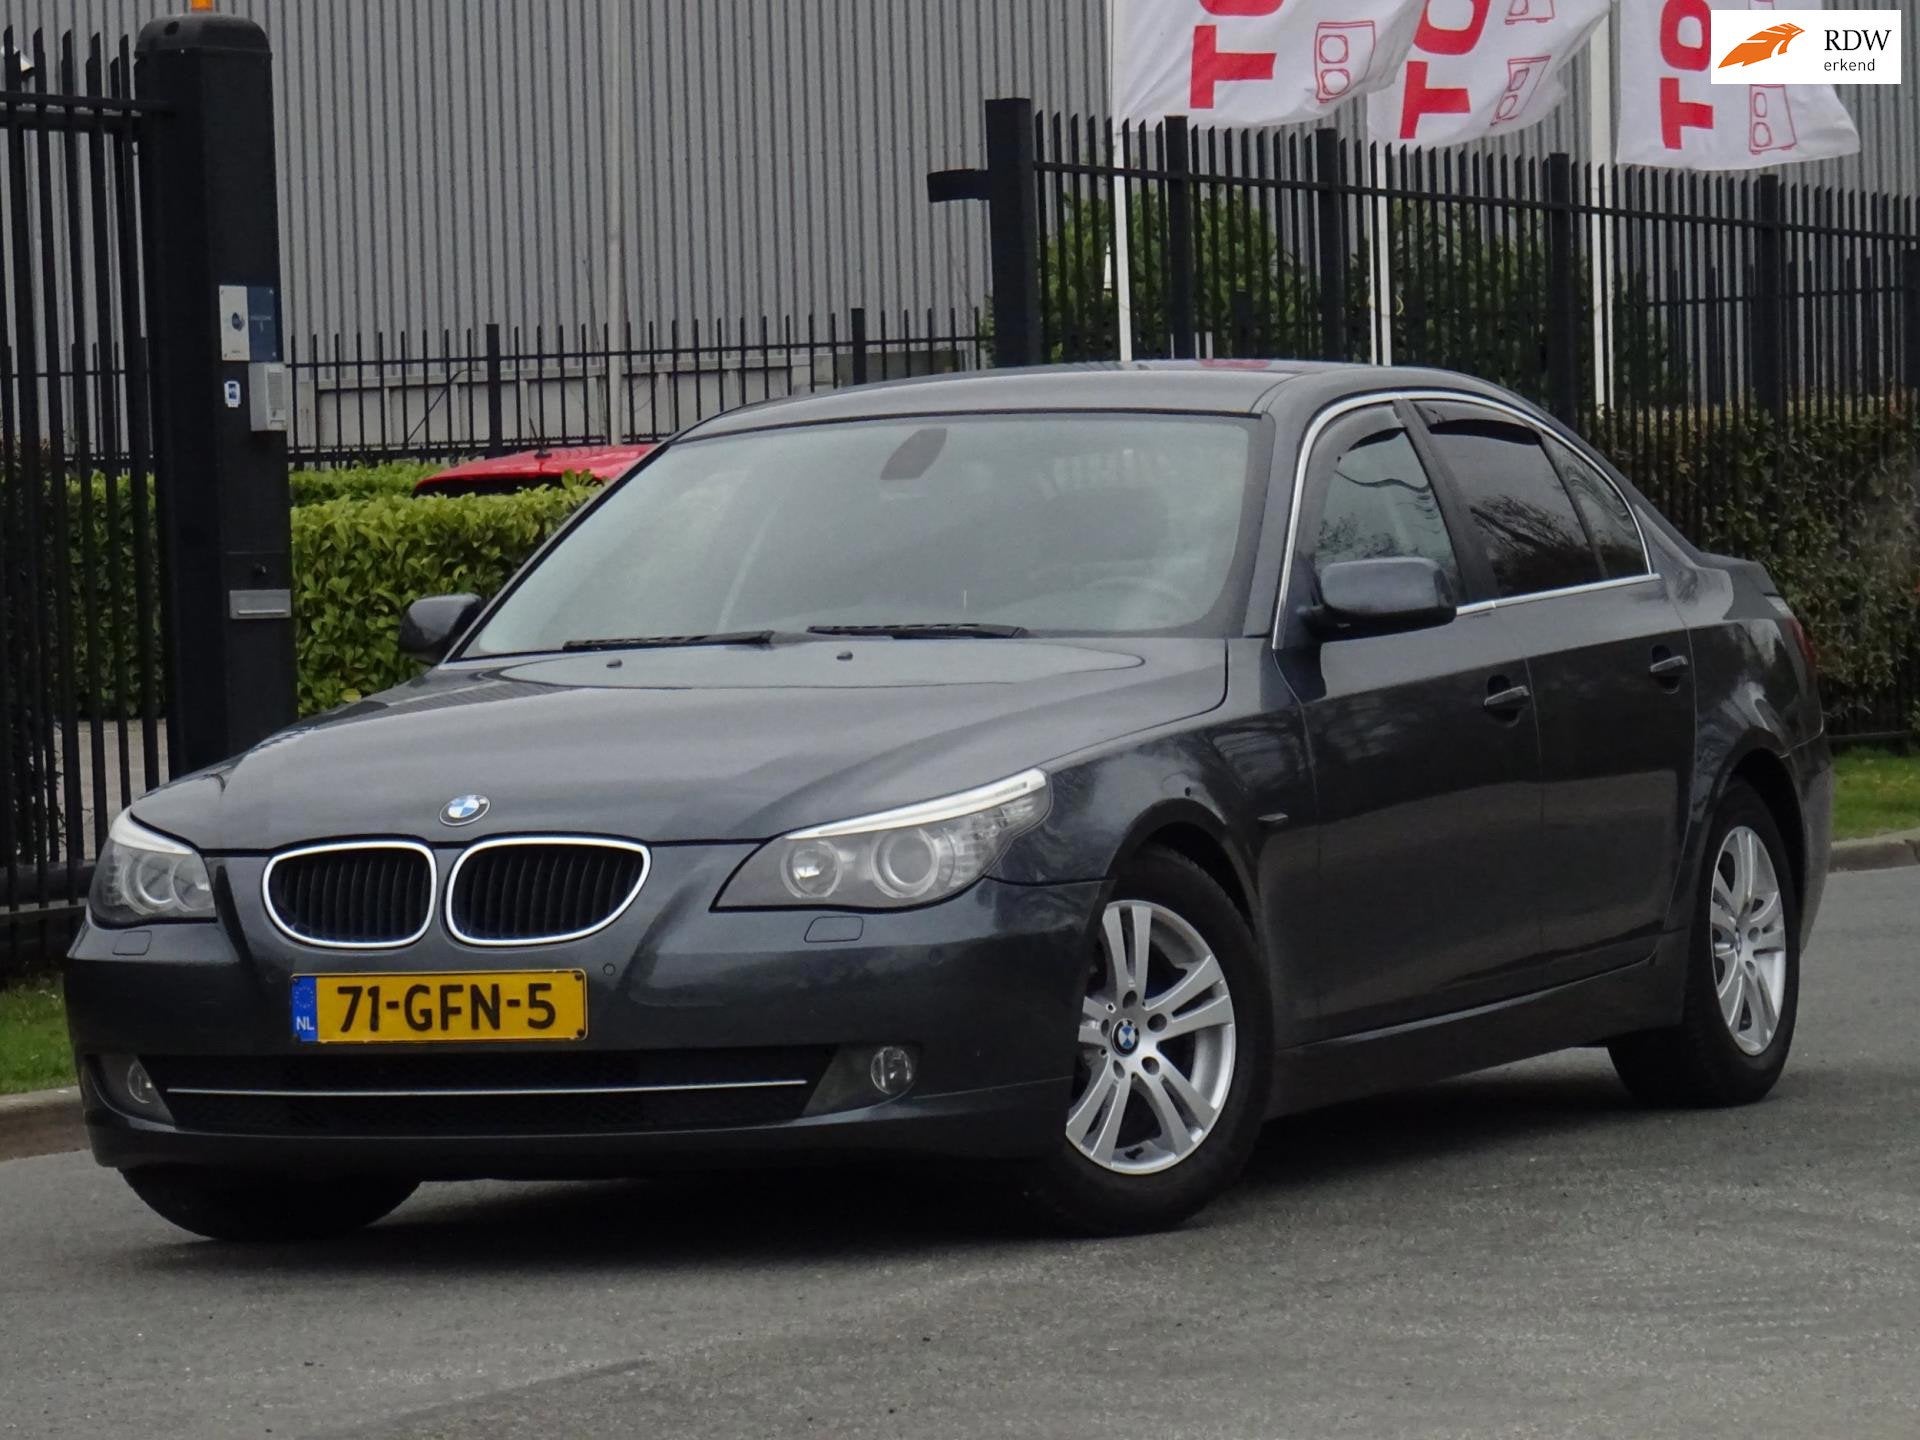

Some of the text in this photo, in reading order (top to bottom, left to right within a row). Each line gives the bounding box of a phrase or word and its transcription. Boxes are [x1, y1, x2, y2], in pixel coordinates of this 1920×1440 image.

[1190, 0, 1284, 108] T
[295, 1016, 315, 1031] NL
[336, 982, 556, 1033] 71-GFN-5
